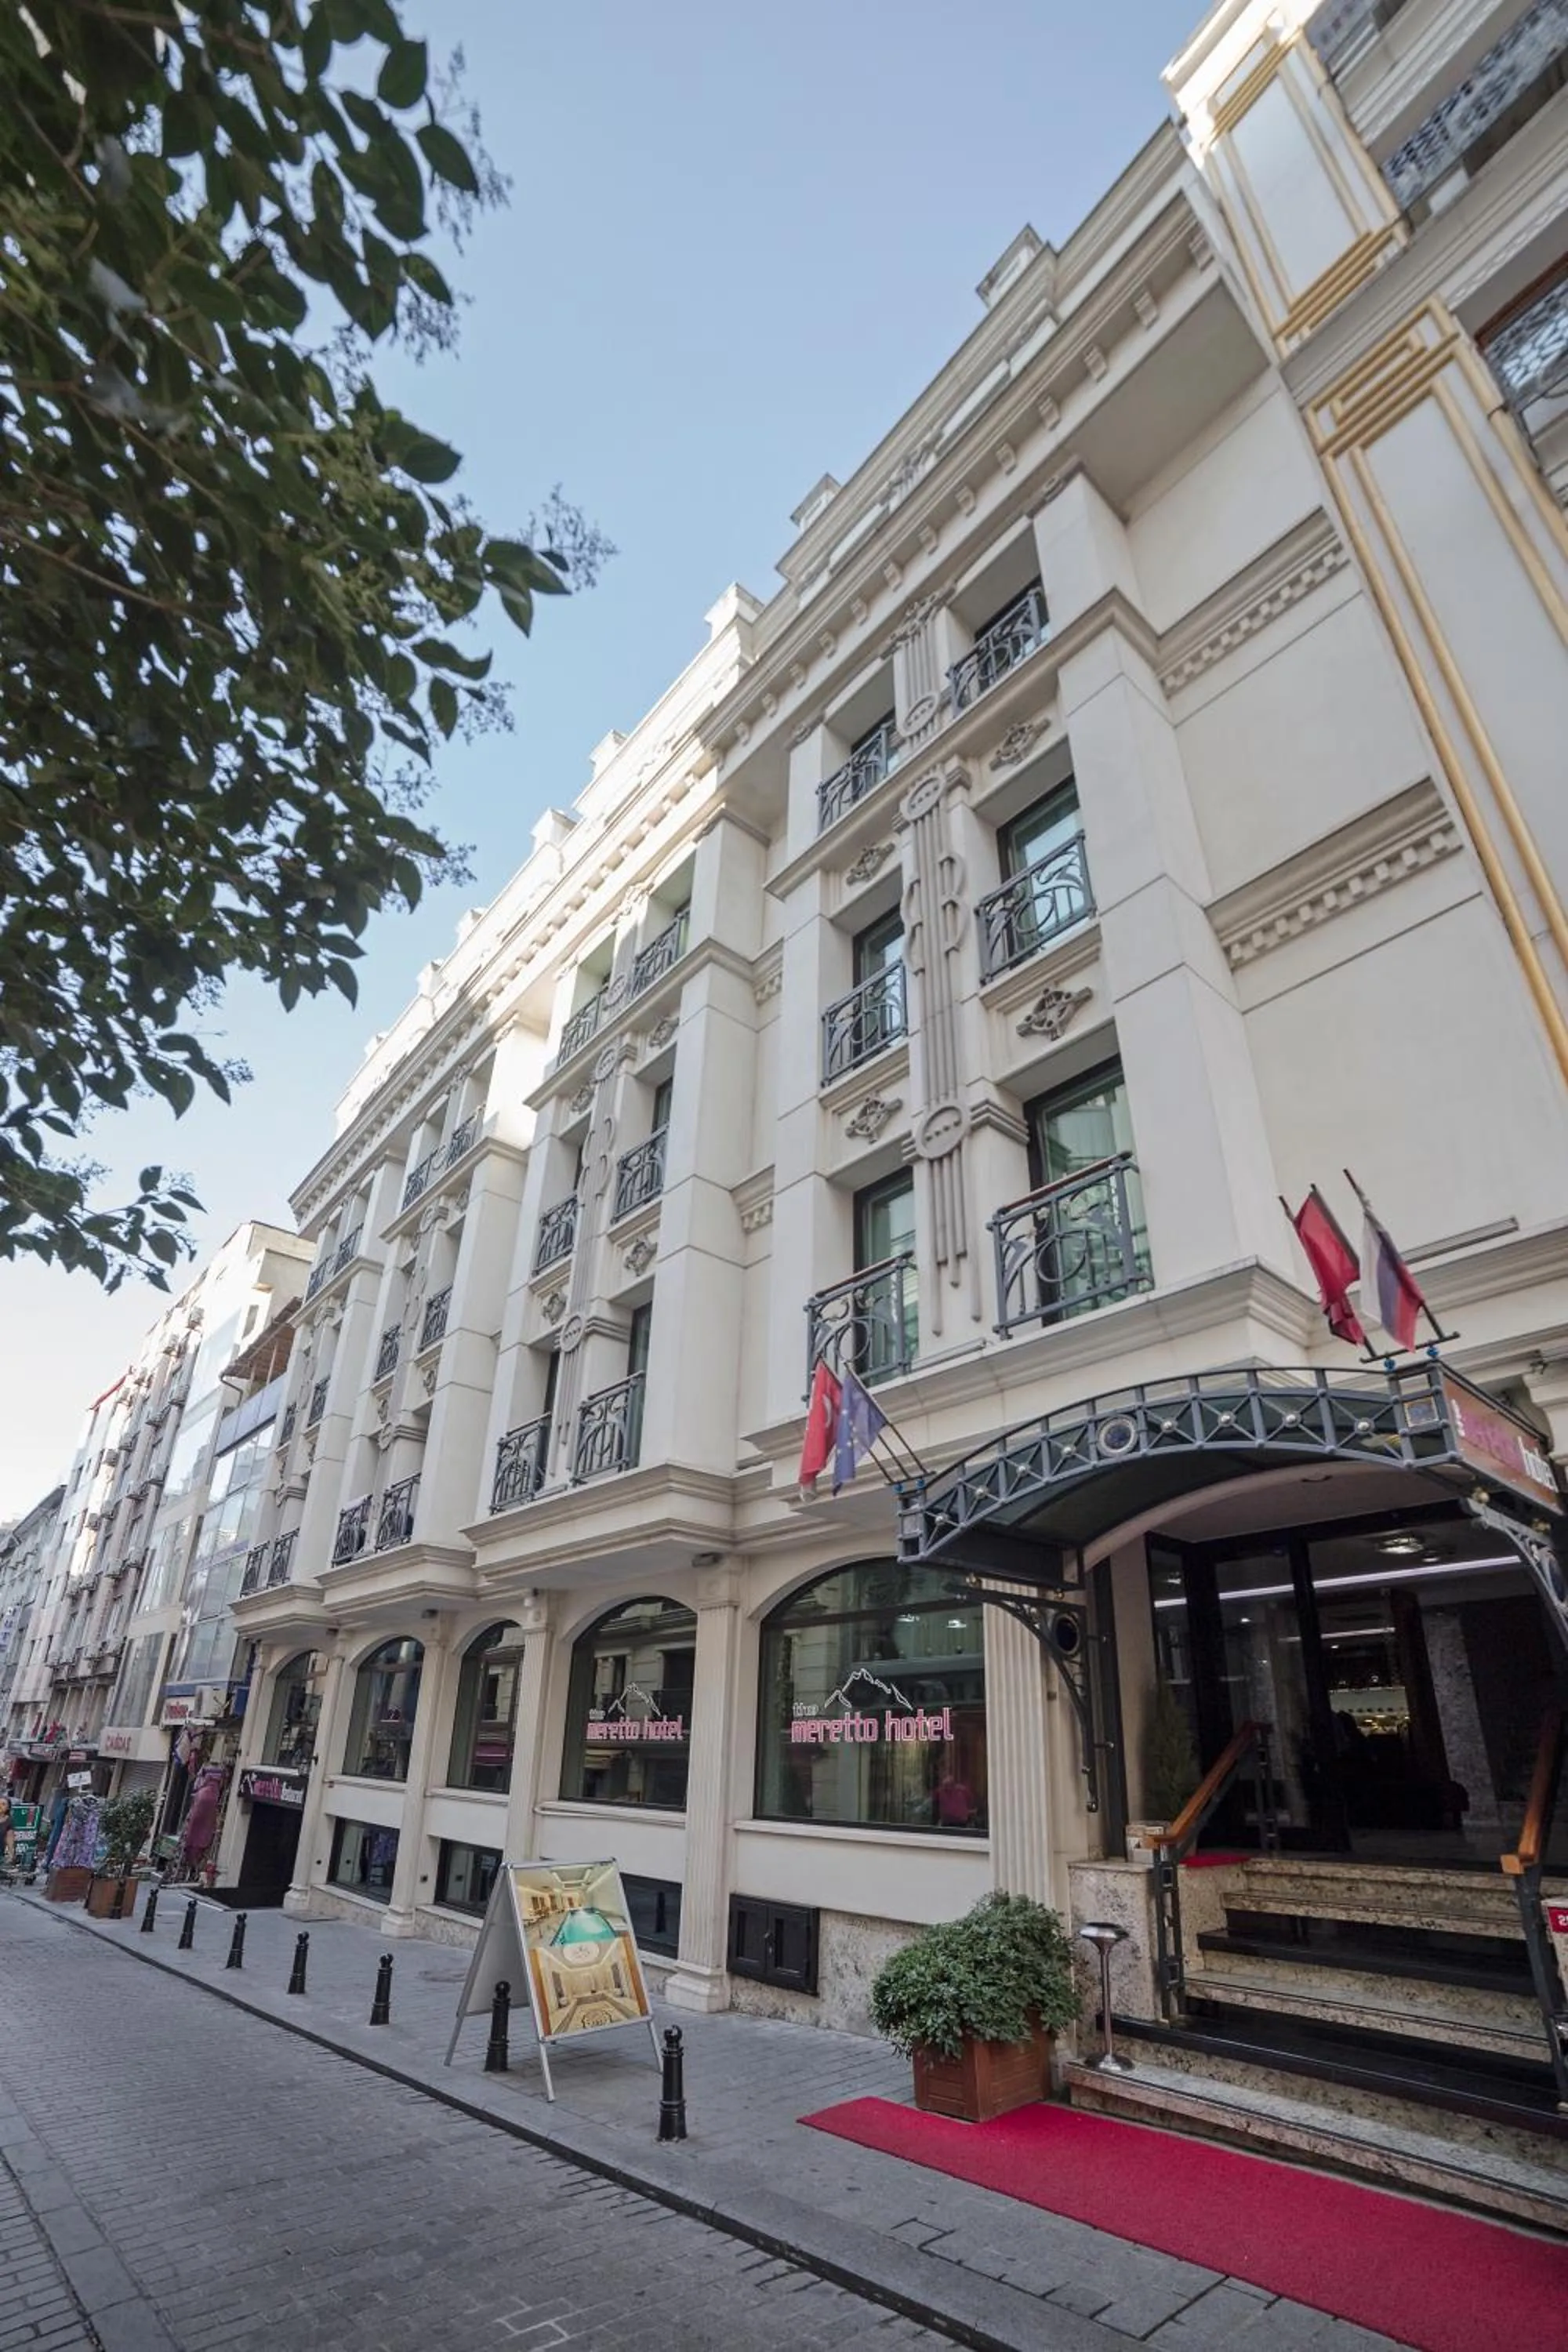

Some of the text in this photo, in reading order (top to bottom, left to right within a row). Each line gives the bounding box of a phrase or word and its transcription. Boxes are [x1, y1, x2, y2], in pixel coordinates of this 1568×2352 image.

[586, 1715, 683, 1740] meretto hotel
[791, 1707, 954, 1744] meretto hotel
